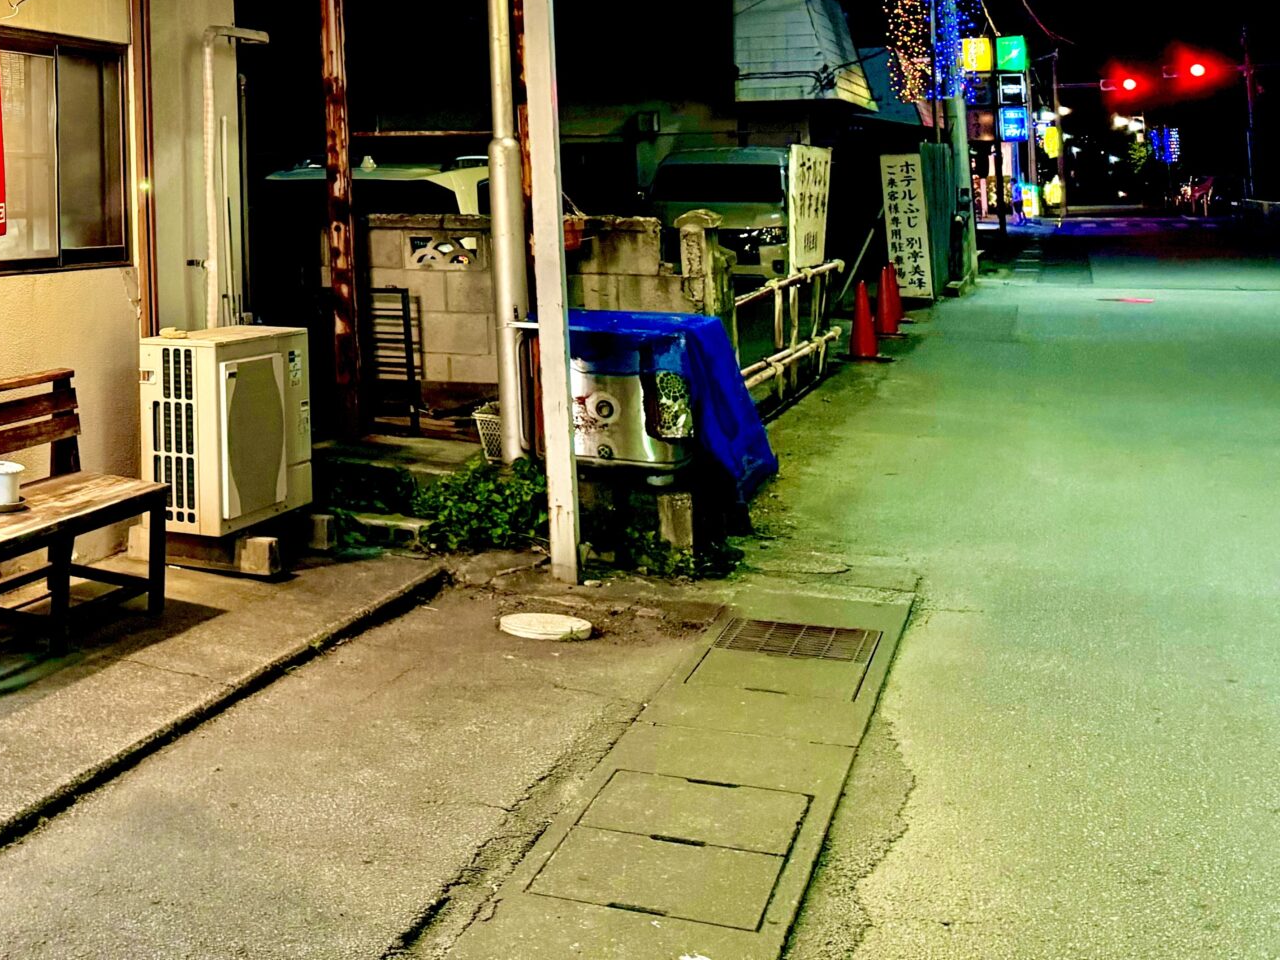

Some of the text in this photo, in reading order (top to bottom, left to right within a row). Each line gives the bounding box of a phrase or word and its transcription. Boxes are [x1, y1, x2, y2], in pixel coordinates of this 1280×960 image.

[900, 161, 920, 228] ホテルふじ
